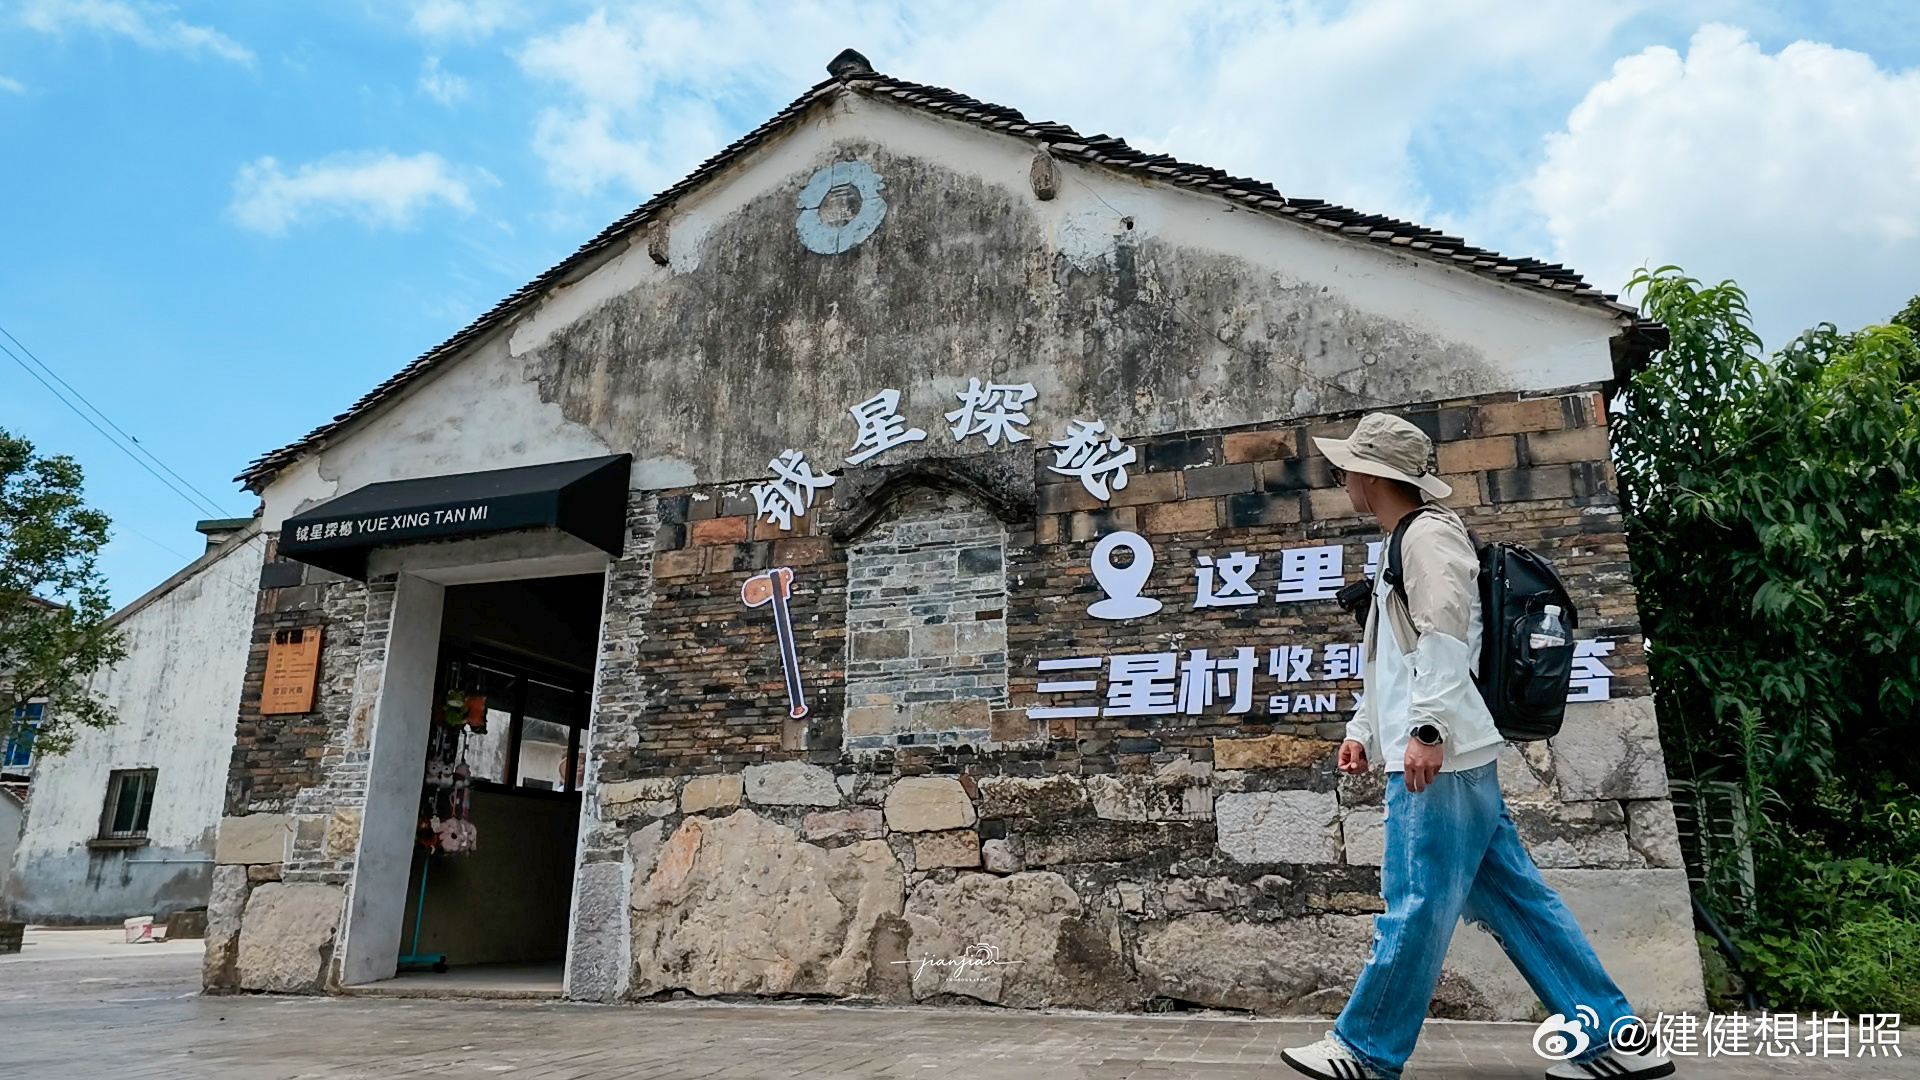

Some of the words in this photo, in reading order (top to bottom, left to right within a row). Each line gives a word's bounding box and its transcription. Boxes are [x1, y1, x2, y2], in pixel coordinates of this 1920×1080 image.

[296, 520, 353, 542] 钺星探秘
[357, 516, 389, 534] YUE
[390, 512, 430, 530] XING
[434, 507, 466, 525] TAN
[469, 505, 488, 521] MI
[1193, 542, 1383, 608] 这里
[1269, 693, 1337, 714] SAN
